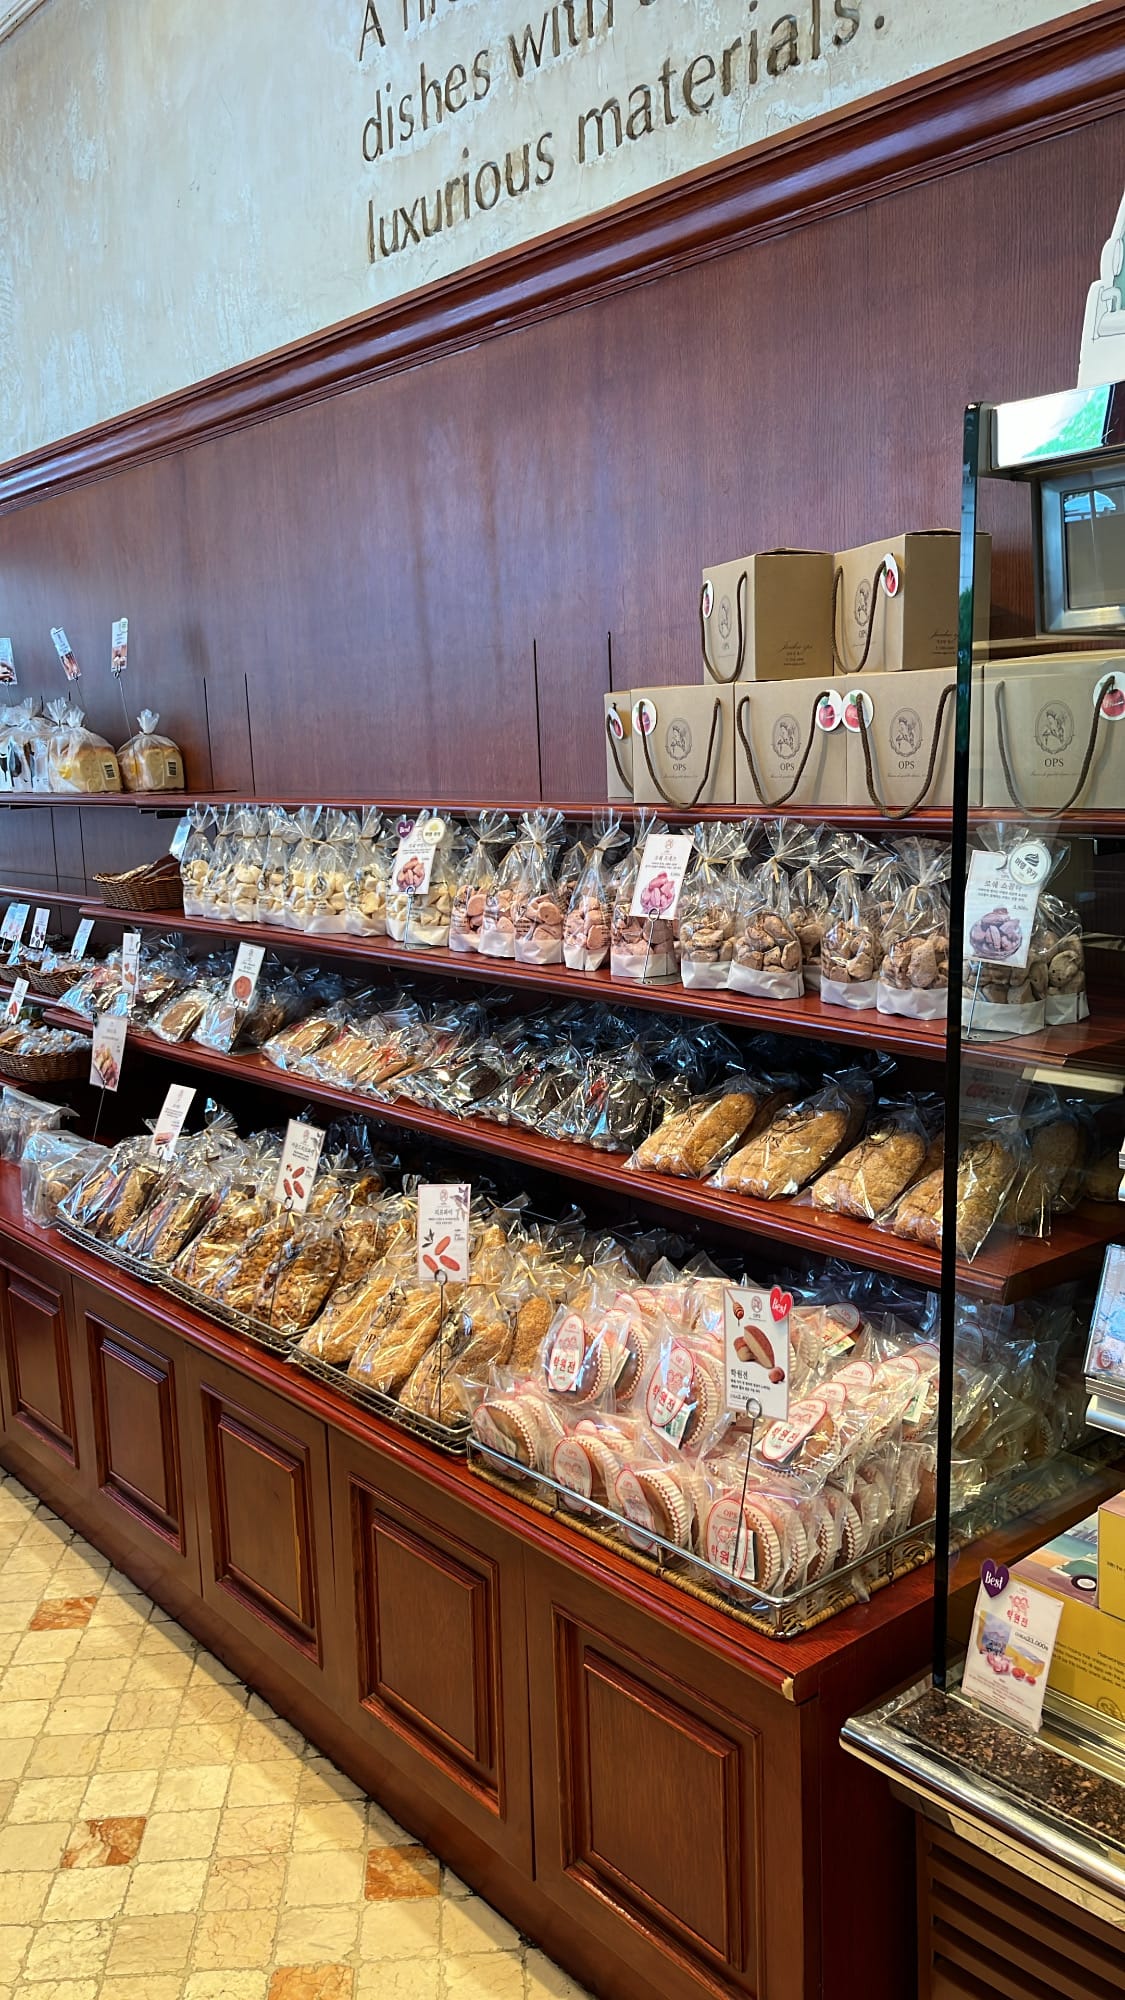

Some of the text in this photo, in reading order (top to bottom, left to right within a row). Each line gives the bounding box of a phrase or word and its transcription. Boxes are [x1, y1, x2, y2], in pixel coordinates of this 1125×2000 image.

[358, 0, 387, 62] A
[362, 49, 491, 162] dishes
[367, 0, 886, 263] luxurious materials.
[672, 763, 687, 771] OPS
[780, 762, 795, 771] OPS
[898, 760, 915, 769] OPS
[1044, 758, 1064, 768] OPS
[771, 1297, 787, 1315] Best
[553, 1356, 576, 1374] 학원전
[771, 1426, 800, 1444] 학원전
[984, 1571, 1003, 1590] Best
[1006, 1609, 1029, 1628] 학원전
